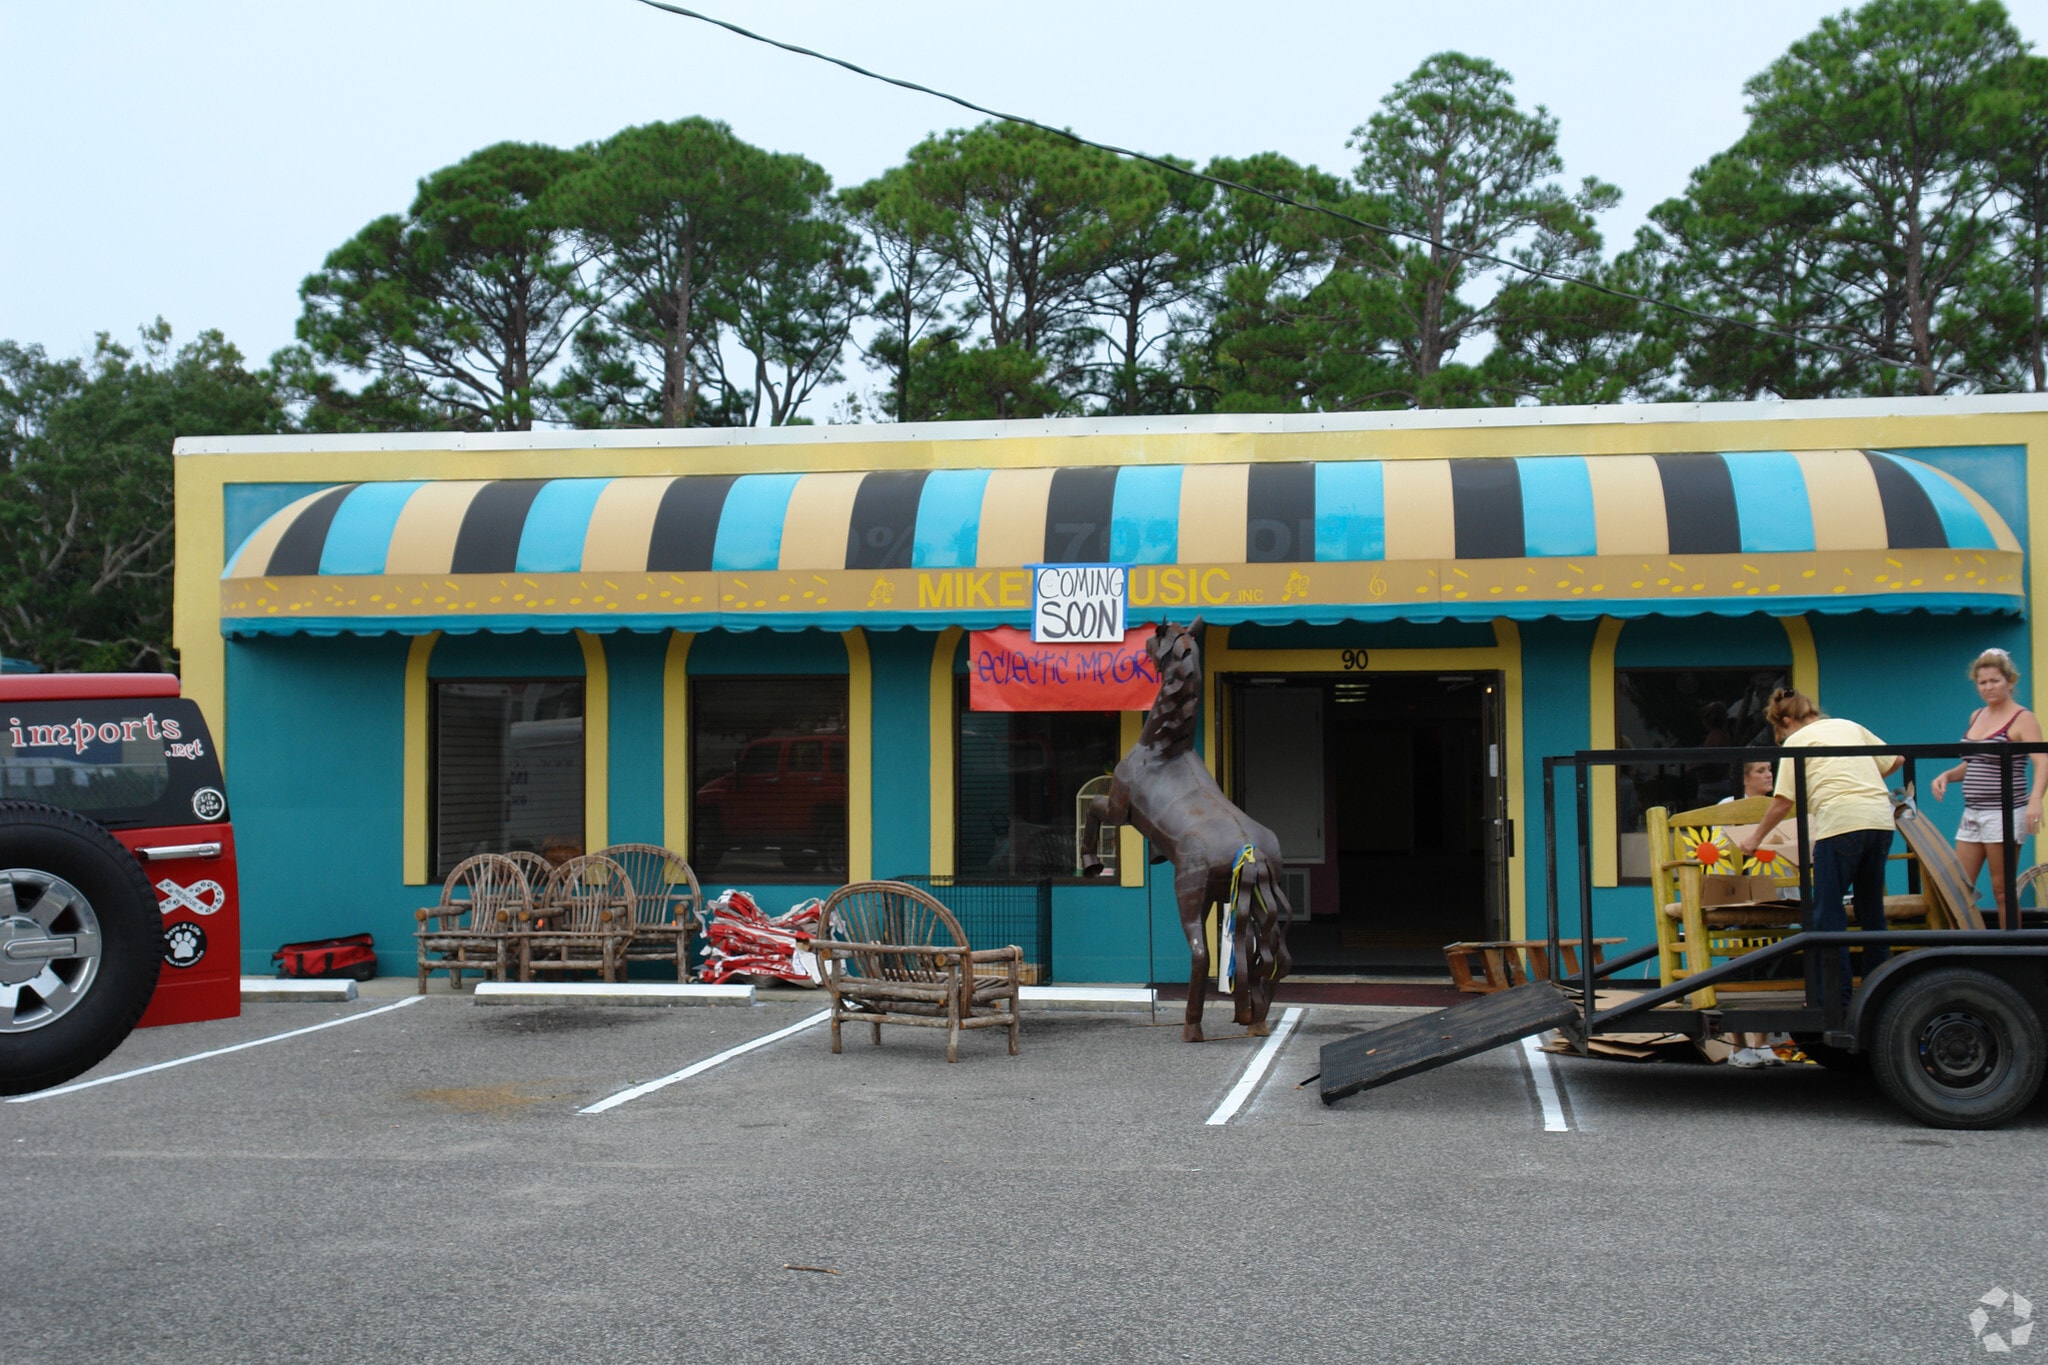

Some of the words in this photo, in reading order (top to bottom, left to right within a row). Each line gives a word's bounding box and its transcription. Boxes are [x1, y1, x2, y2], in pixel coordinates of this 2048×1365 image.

[918, 571, 1033, 608] MIKE'
[1128, 567, 1230, 605] USIC
[1038, 567, 1124, 599] COMING
[1041, 598, 1117, 639] SOON
[1341, 649, 1368, 670] 90
[10, 712, 182, 755] imports
[165, 739, 204, 760] .net
[174, 889, 197, 908] RESCUE
